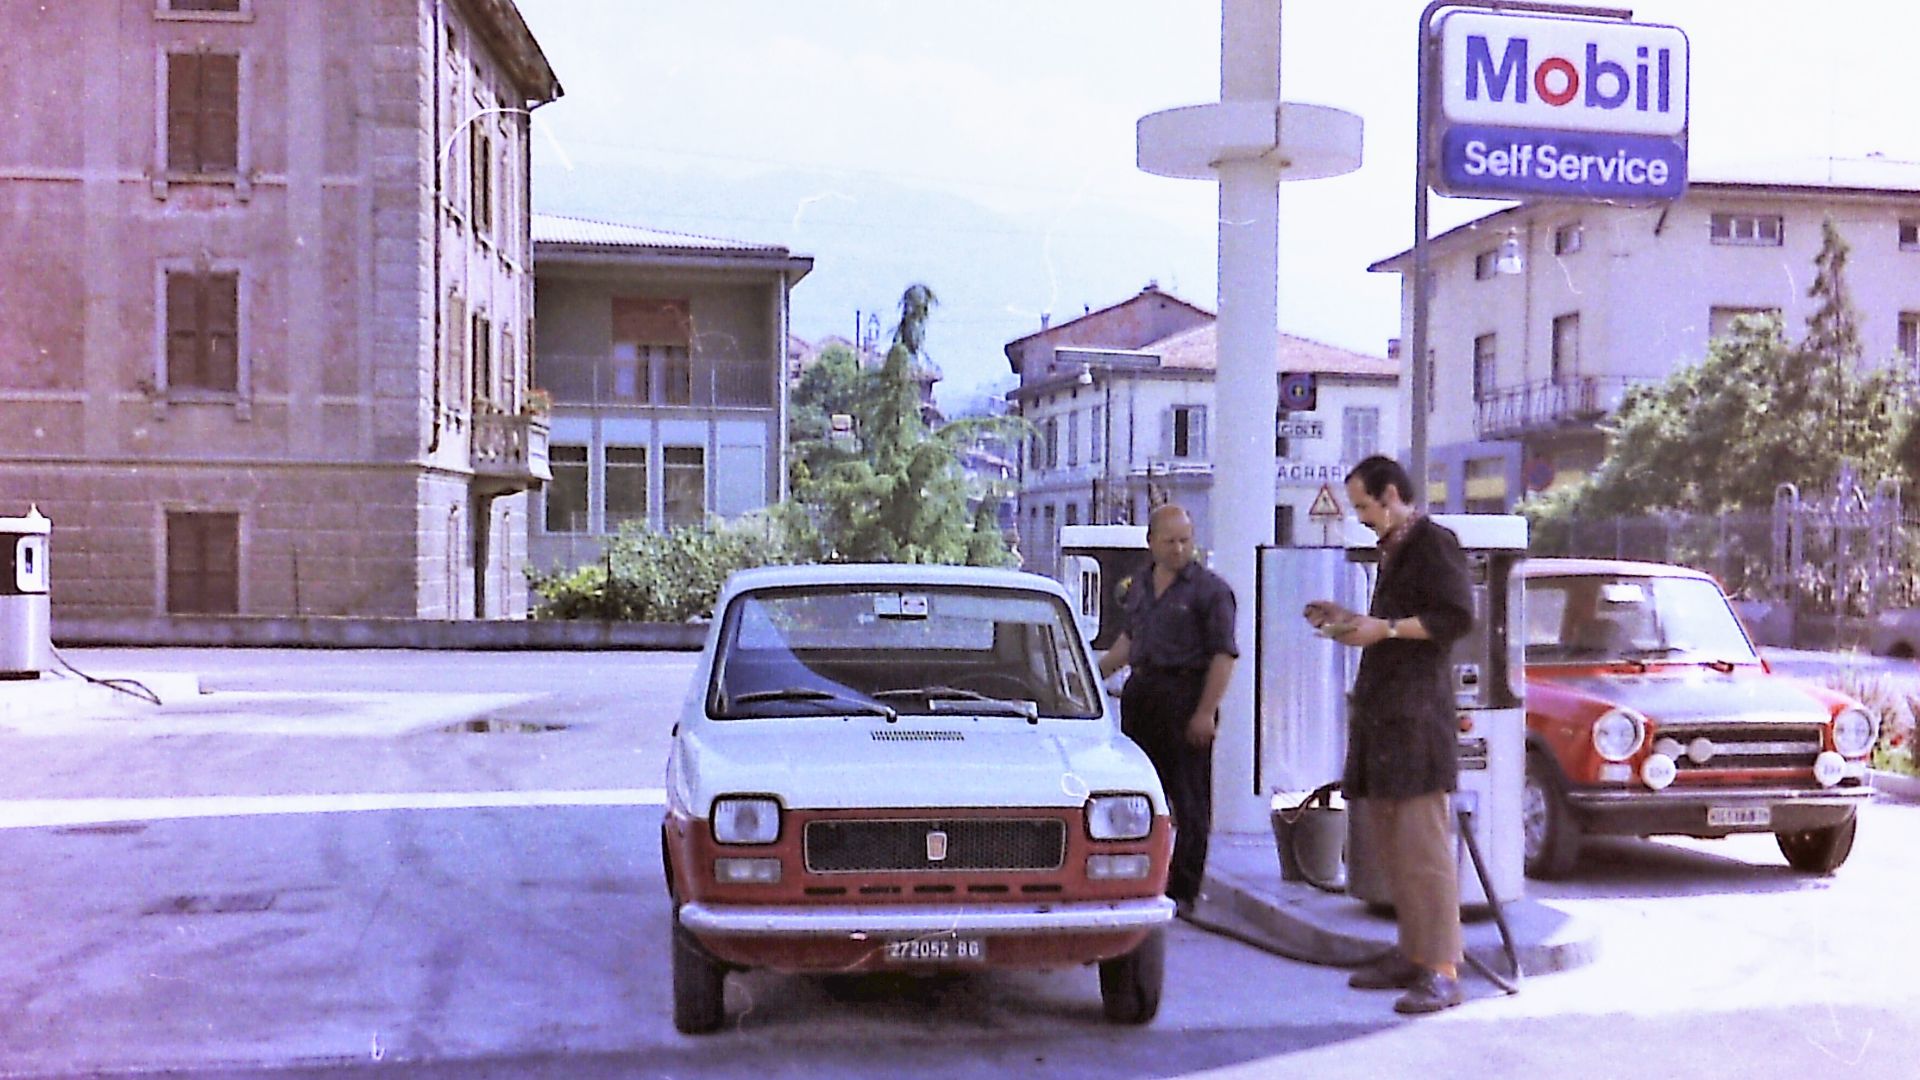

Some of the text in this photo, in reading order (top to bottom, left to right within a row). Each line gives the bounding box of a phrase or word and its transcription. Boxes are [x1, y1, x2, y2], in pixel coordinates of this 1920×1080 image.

[1465, 35, 1670, 112] Mobil
[1464, 140, 1669, 185] Self Service
[890, 941, 949, 957] 272052
